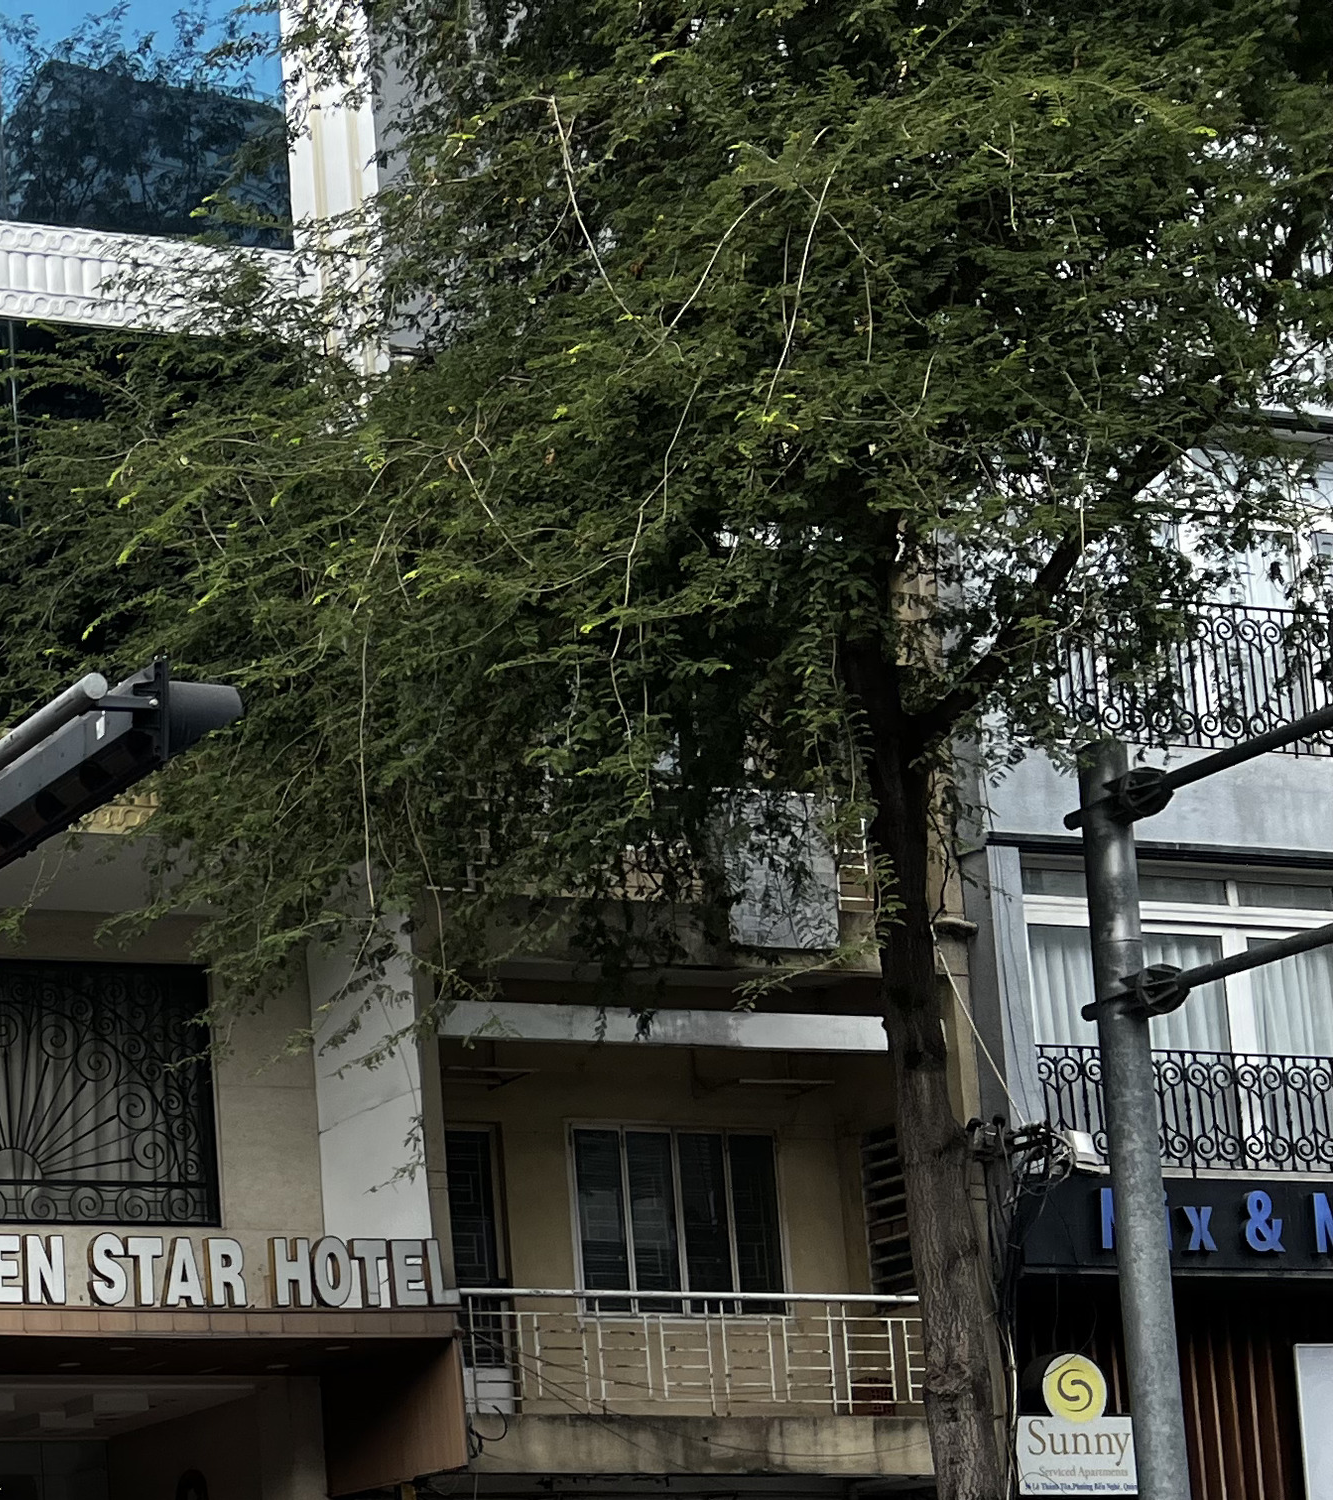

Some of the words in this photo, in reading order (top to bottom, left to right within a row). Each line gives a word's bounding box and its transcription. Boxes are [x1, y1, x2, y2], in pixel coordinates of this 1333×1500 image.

[1246, 1189, 1286, 1252] &
[88, 1232, 247, 1307] STAR
[267, 1235, 460, 1309] HOTEL
[1027, 1419, 1132, 1467] Sunny
[1078, 1466, 1129, 1480] Apartments
